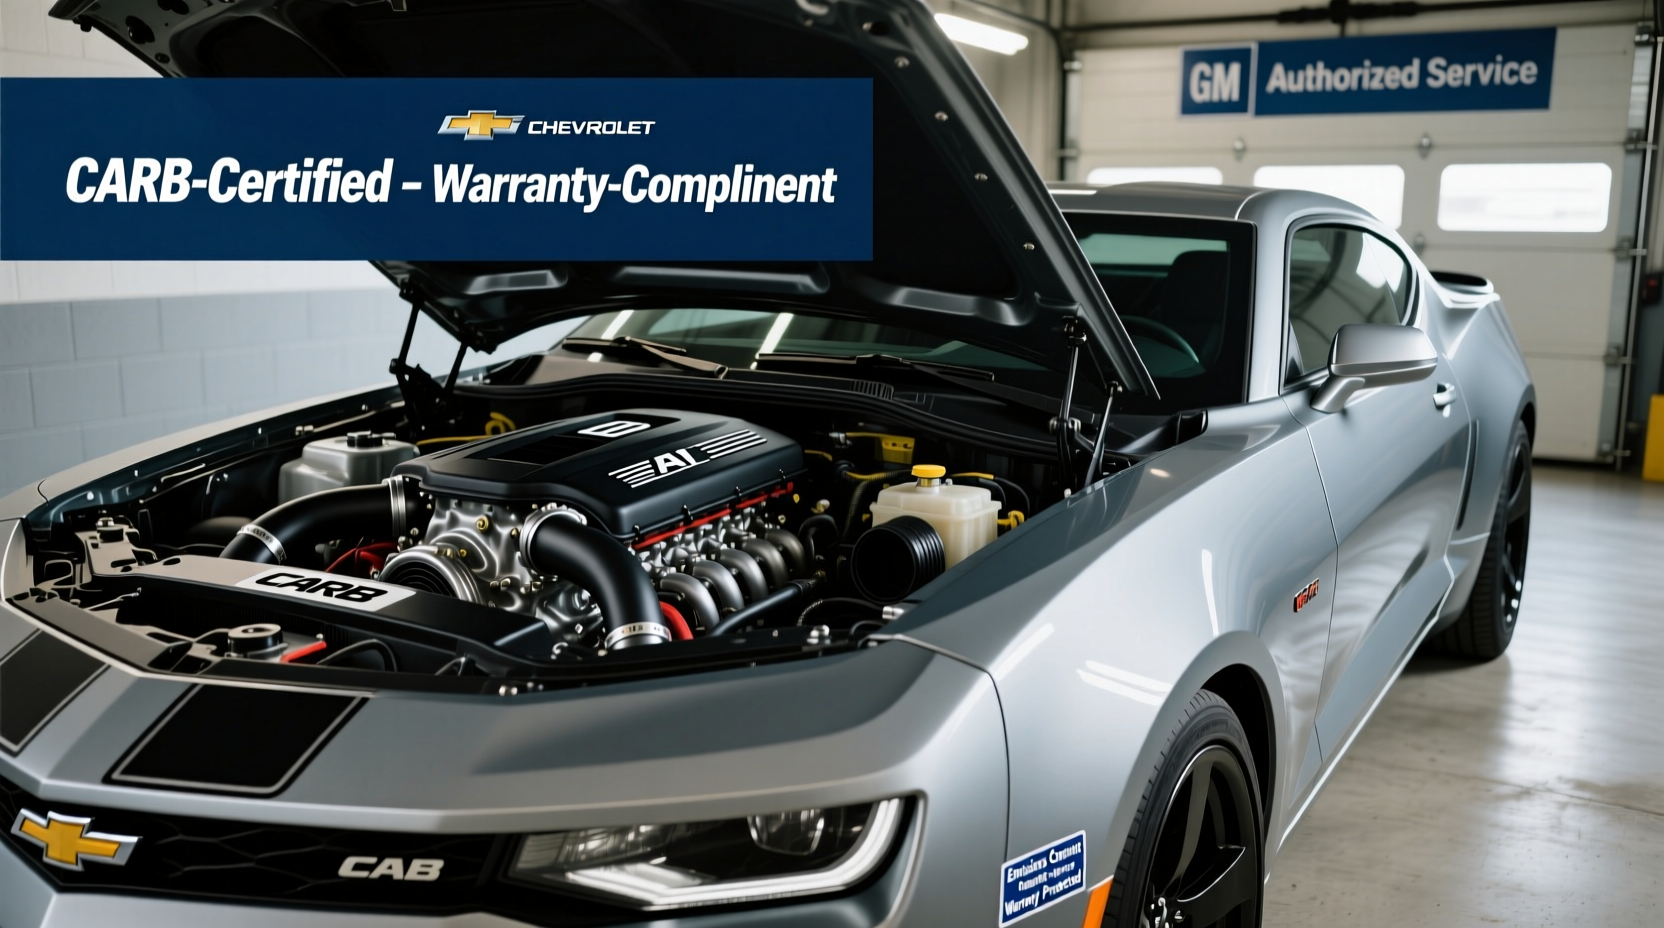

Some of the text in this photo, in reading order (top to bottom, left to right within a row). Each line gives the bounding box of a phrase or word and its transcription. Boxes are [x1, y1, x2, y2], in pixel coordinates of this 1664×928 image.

[1189, 61, 1241, 103] GM
[1265, 54, 1538, 94] Authorized Service
[255, 572, 389, 603] CARB
[338, 856, 445, 882] CAB
